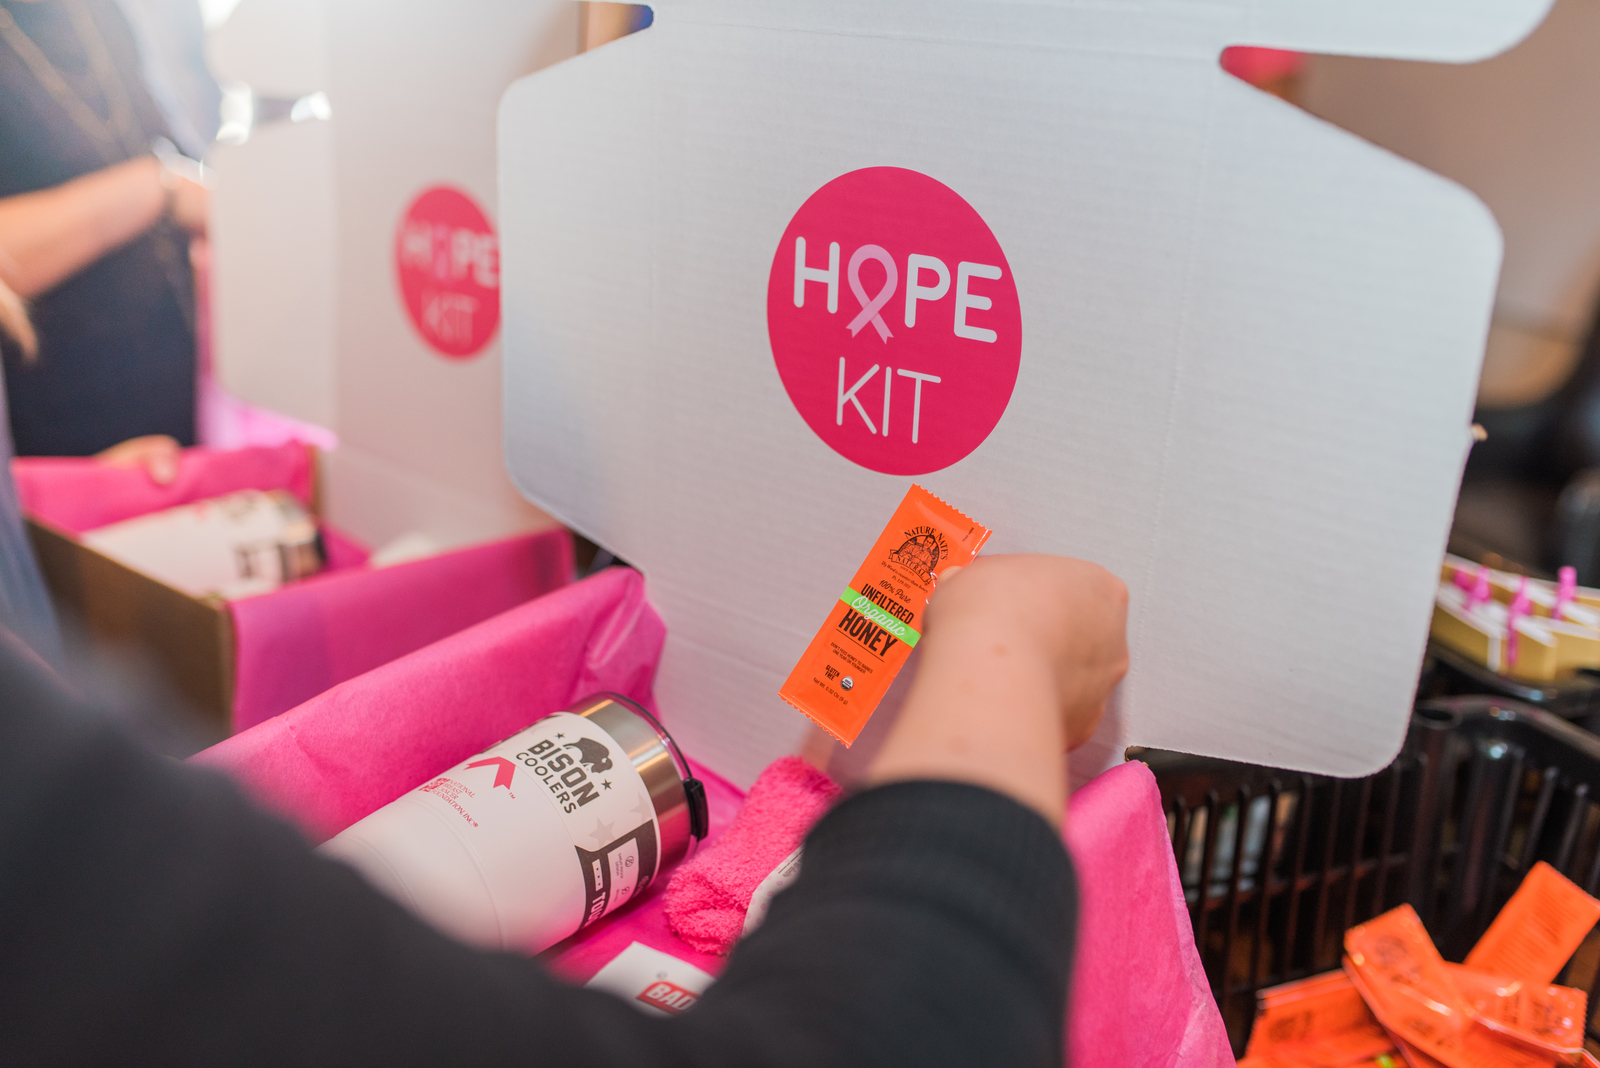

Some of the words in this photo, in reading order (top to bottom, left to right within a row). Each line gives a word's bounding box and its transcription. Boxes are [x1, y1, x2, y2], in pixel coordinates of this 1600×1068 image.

[793, 236, 1003, 344] HOPE
[836, 356, 942, 444] KIT
[904, 526, 936, 540] NATURE
[860, 584, 914, 624] UNFILTERED
[879, 580, 895, 594] 100%
[895, 588, 911, 604] Pure
[838, 608, 898, 657] HONEY
[852, 596, 906, 636] Organic
[825, 665, 840, 677] GLUTEN
[825, 672, 835, 681] FREE
[516, 752, 577, 814] COOLERS
[527, 739, 600, 808] BISON
[645, 982, 698, 1011] BAD
